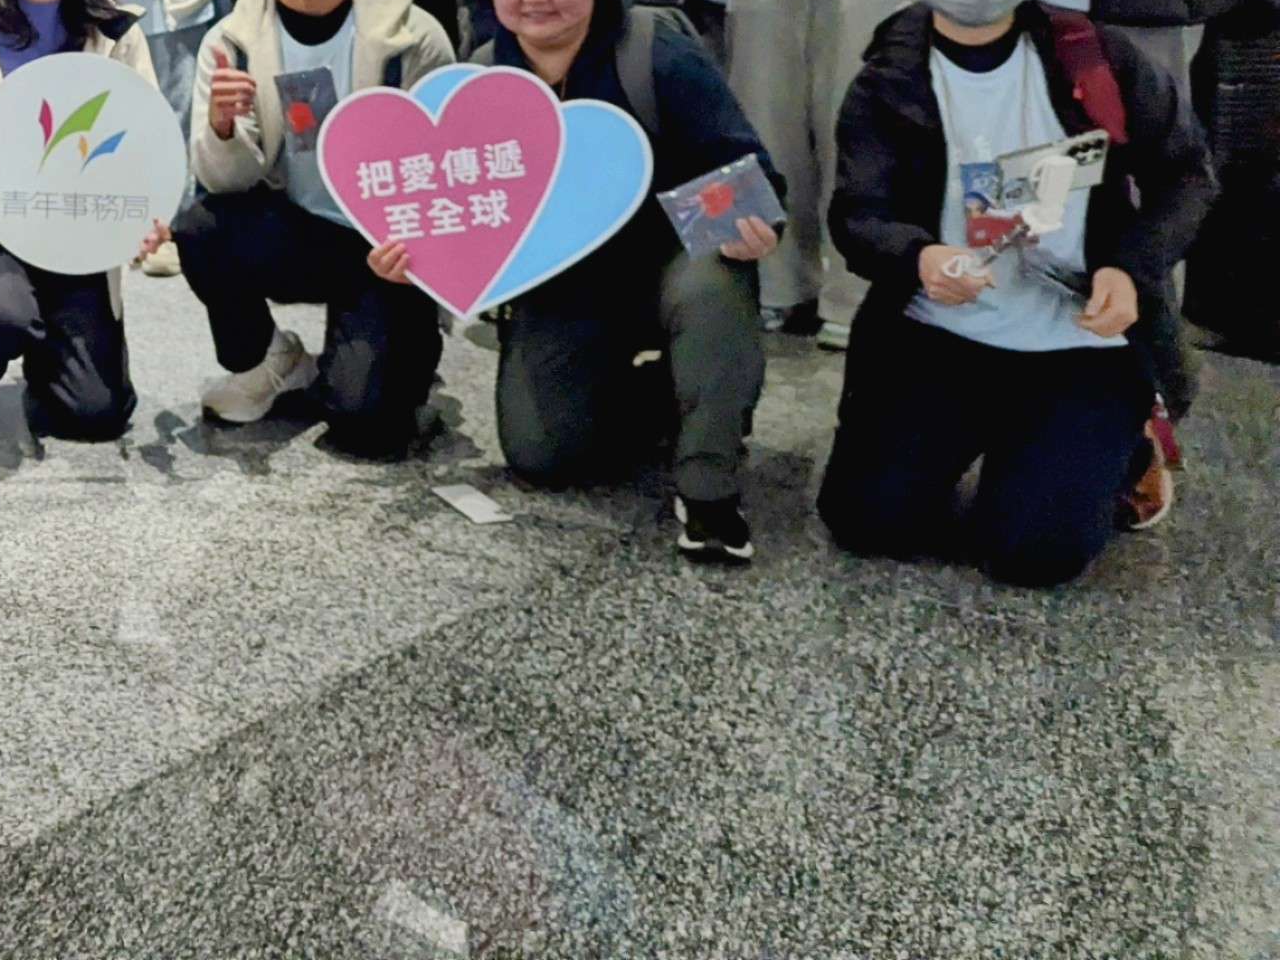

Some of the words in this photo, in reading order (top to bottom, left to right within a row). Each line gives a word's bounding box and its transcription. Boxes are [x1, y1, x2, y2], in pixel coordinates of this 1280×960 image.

[356, 139, 526, 201] 把愛傳遞
[1, 190, 149, 222] 青年事務局
[383, 189, 512, 241] 至全球
